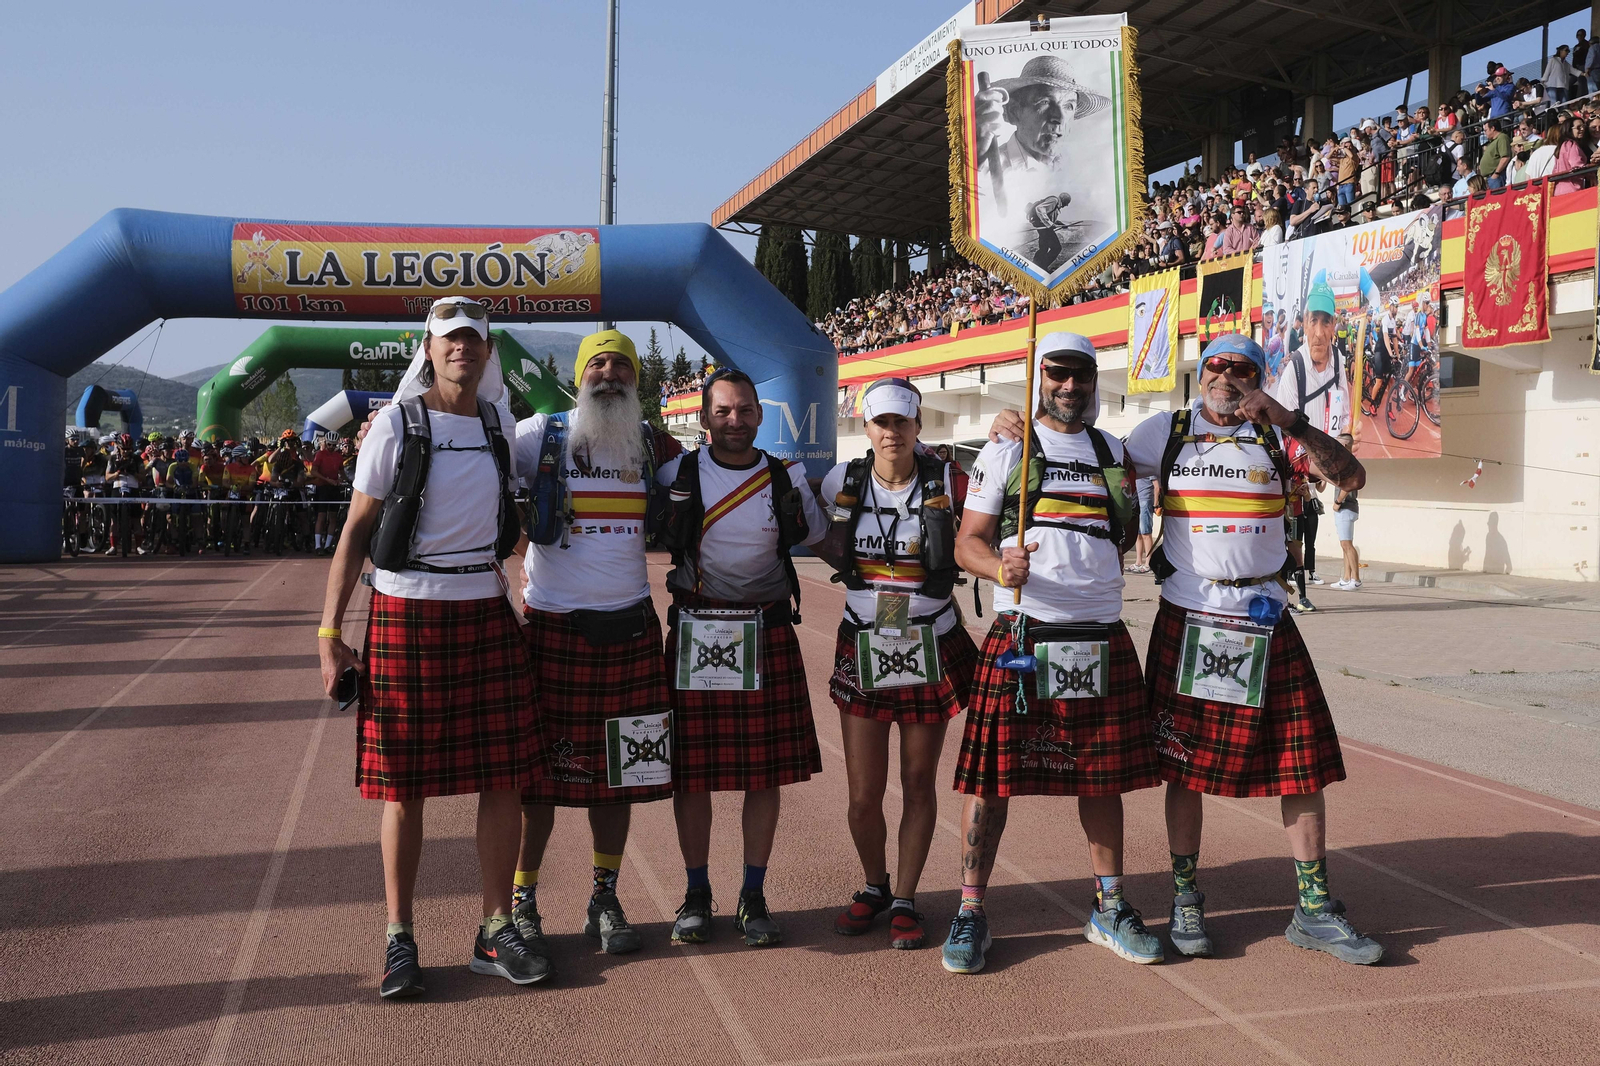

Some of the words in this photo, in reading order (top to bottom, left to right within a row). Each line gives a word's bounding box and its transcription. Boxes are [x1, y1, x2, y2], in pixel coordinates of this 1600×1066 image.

[918, 18, 957, 57] AYUNTAMIENTO
[964, 46, 995, 57] UNO
[999, 42, 1038, 55] IGUAL
[1040, 40, 1069, 52] QUE
[1070, 37, 1119, 50] TODOS
[914, 62, 921, 75] DE
[922, 48, 941, 69] RONDA
[1352, 229, 1377, 256] 101
[1380, 225, 1404, 249] km
[285, 250, 351, 287] LA
[362, 242, 551, 288] LEGIÓN
[1071, 244, 1098, 267] PACO
[1360, 251, 1374, 266] 24
[1375, 246, 1404, 263] horas
[1333, 270, 1360, 281] CaixaBank
[243, 295, 291, 312] 101
[298, 293, 347, 313] km
[480, 298, 510, 315] 24
[517, 295, 591, 313] horas
[766, 450, 793, 459] tación
[794, 450, 805, 459] de
[807, 449, 833, 460] málaga
[1043, 470, 1091, 482] erMen
[853, 535, 906, 551] erMen
[1224, 638, 1243, 646] Unicaja
[878, 651, 919, 675] 895
[1202, 653, 1245, 680] 907
[1042, 756, 1075, 773] Viegas
